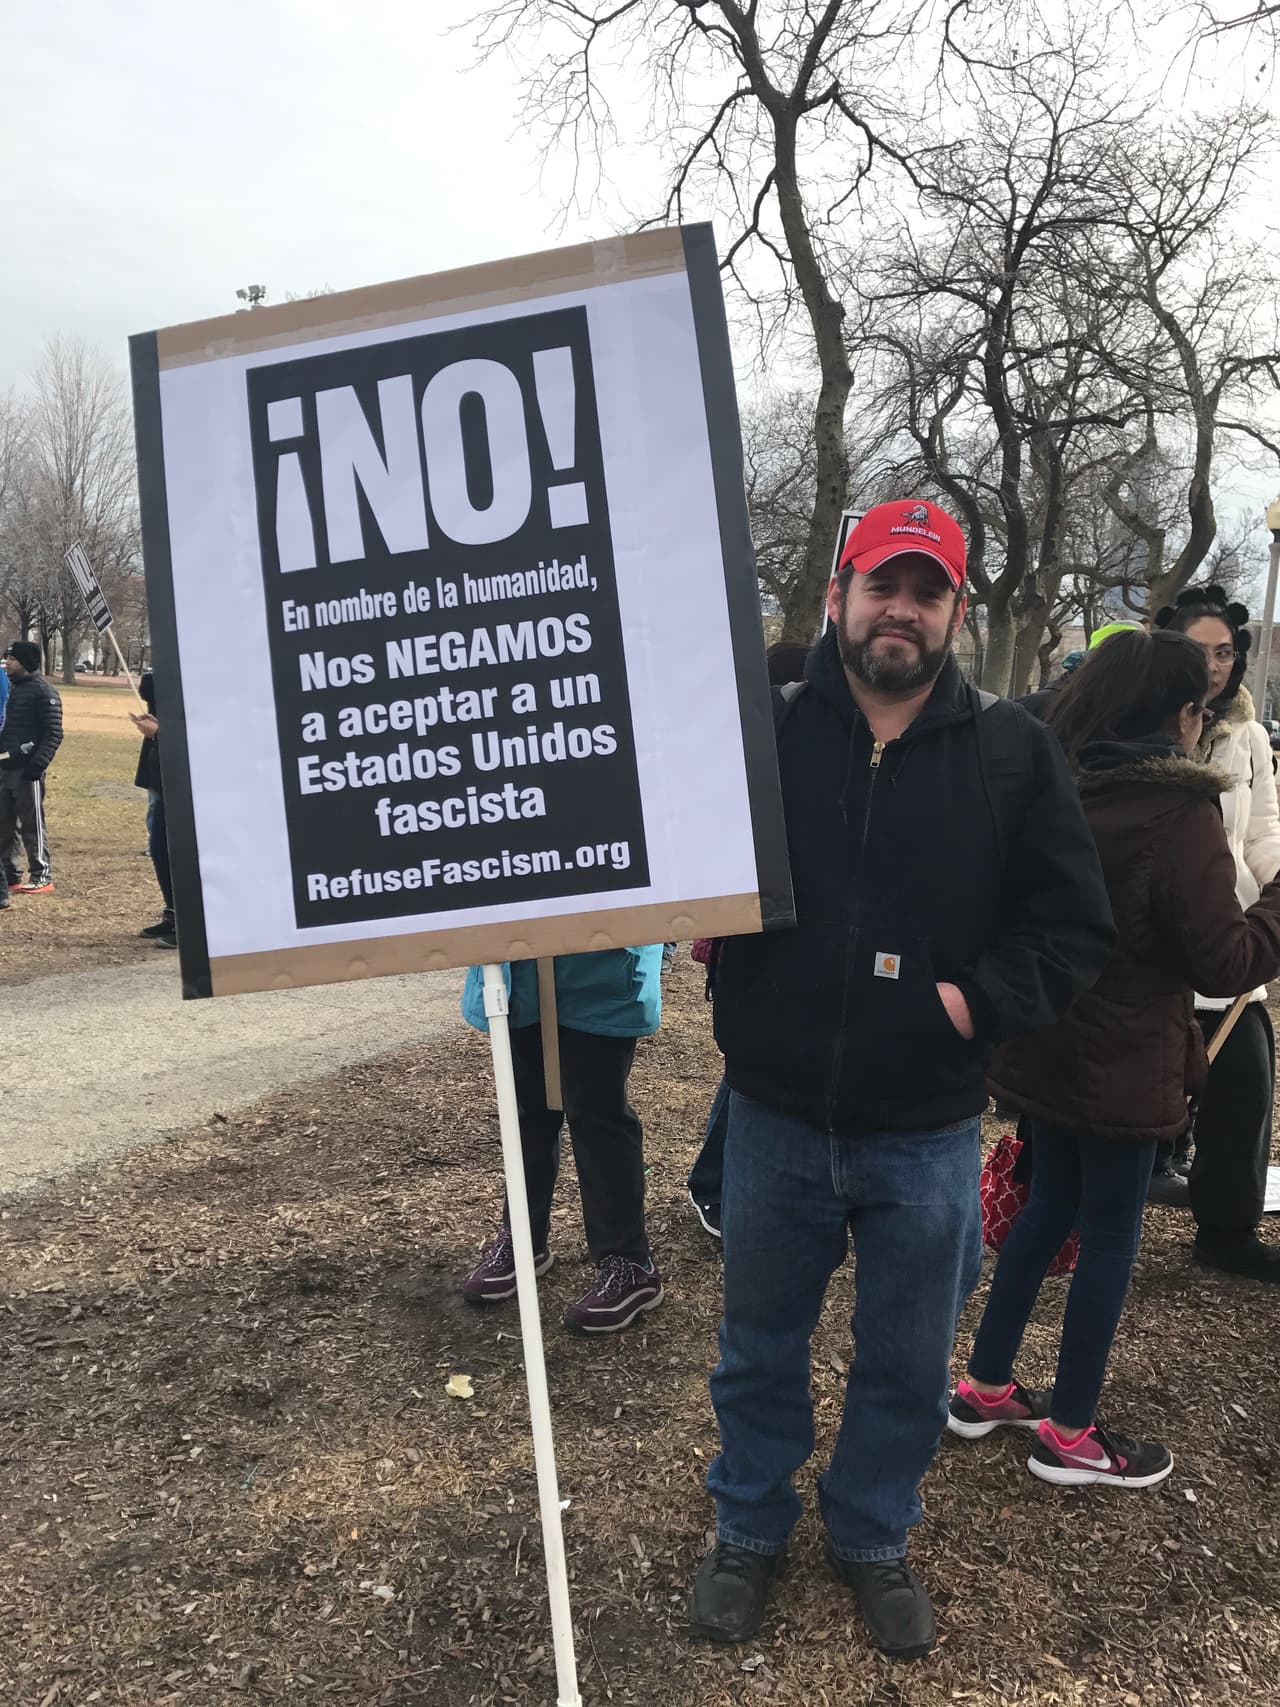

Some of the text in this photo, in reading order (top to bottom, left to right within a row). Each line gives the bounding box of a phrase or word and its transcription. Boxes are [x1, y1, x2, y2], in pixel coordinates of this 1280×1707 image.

[267, 346, 589, 573] ¡NO!
[891, 526, 941, 542] MUNDELEIN
[282, 555, 597, 632] En nombre de la humanidad,
[299, 613, 592, 692] Nos NEGAMOS
[301, 674, 601, 743] a aceptar a un
[297, 722, 618, 795] Estados Unidos
[374, 783, 547, 837] fascista
[306, 841, 631, 902] RefuseFascism.org
